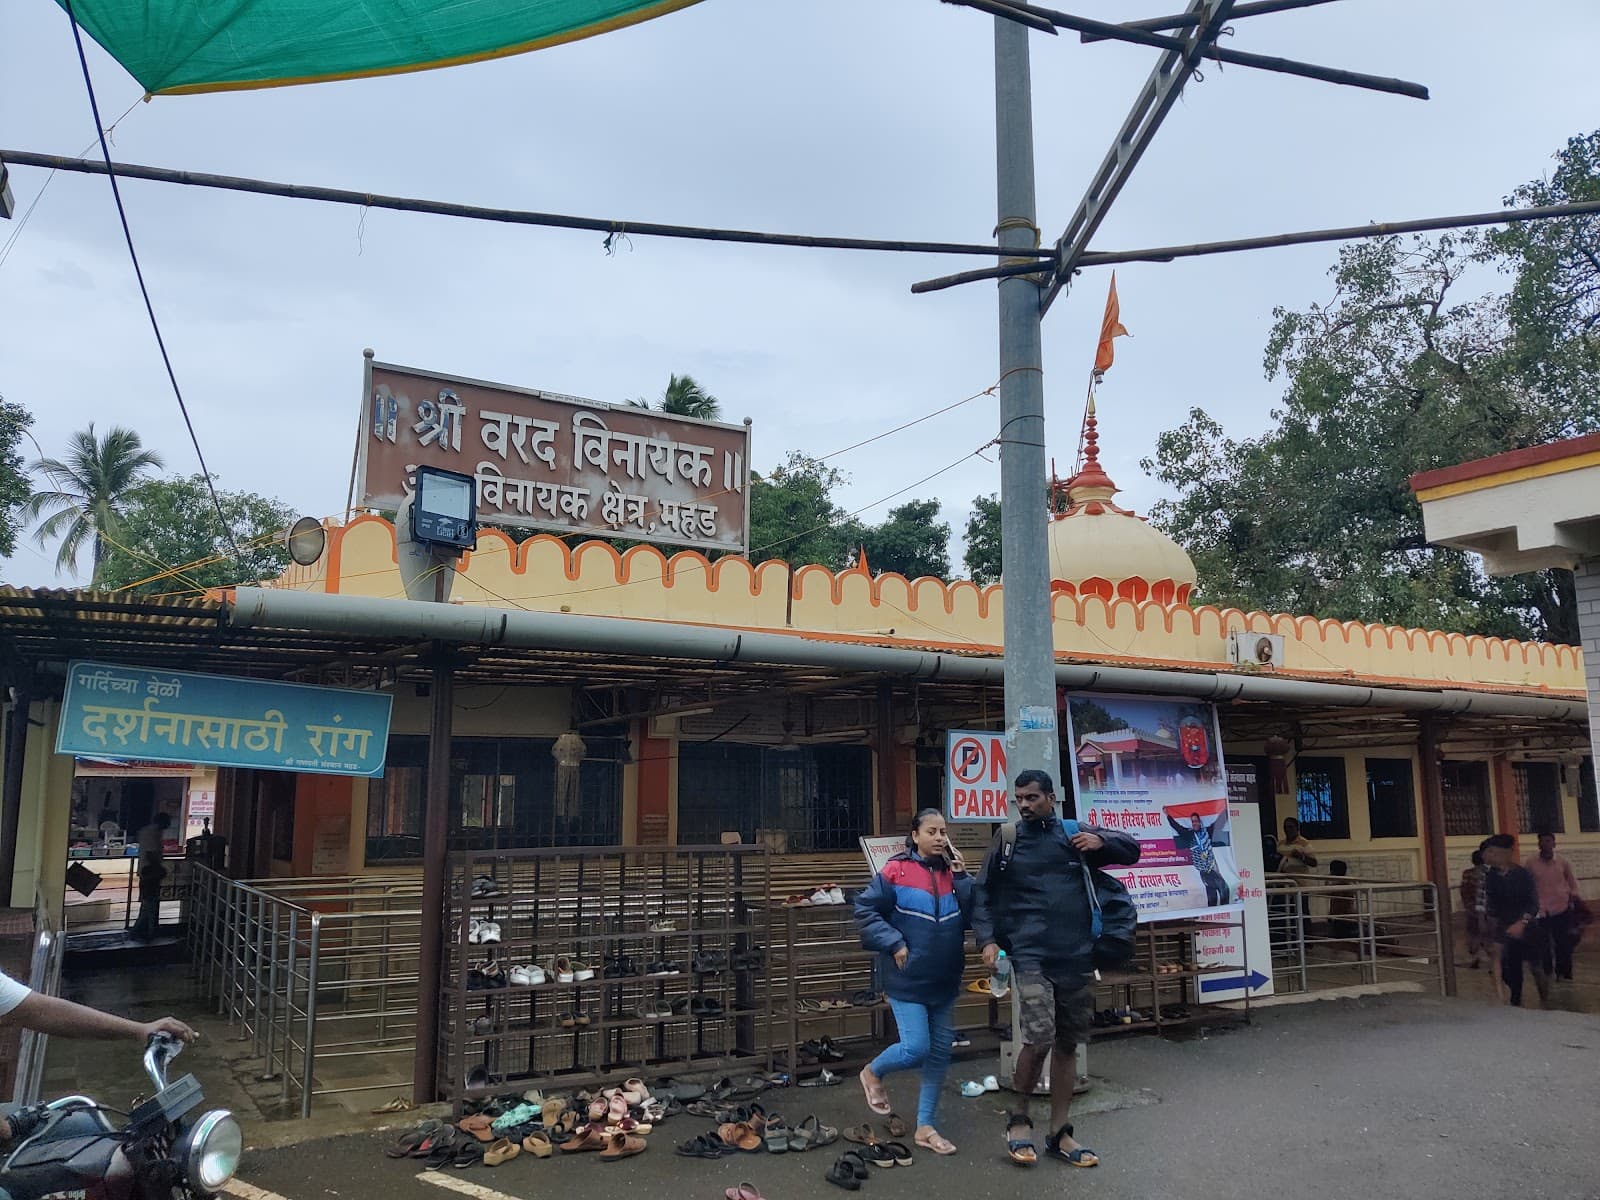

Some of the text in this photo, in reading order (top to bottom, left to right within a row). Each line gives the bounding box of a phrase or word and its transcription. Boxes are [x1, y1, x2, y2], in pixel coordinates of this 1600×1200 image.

[411, 388, 466, 453] श्री
[479, 409, 560, 471] वरद
[572, 410, 715, 489] विनायक
[660, 497, 718, 539] महड
[146, 676, 182, 698] वेळी
[81, 697, 373, 760] दर्शनासाठी रांग
[990, 739, 1007, 783] N
[954, 788, 1008, 817] PARK
[1164, 873, 1182, 887] महड
